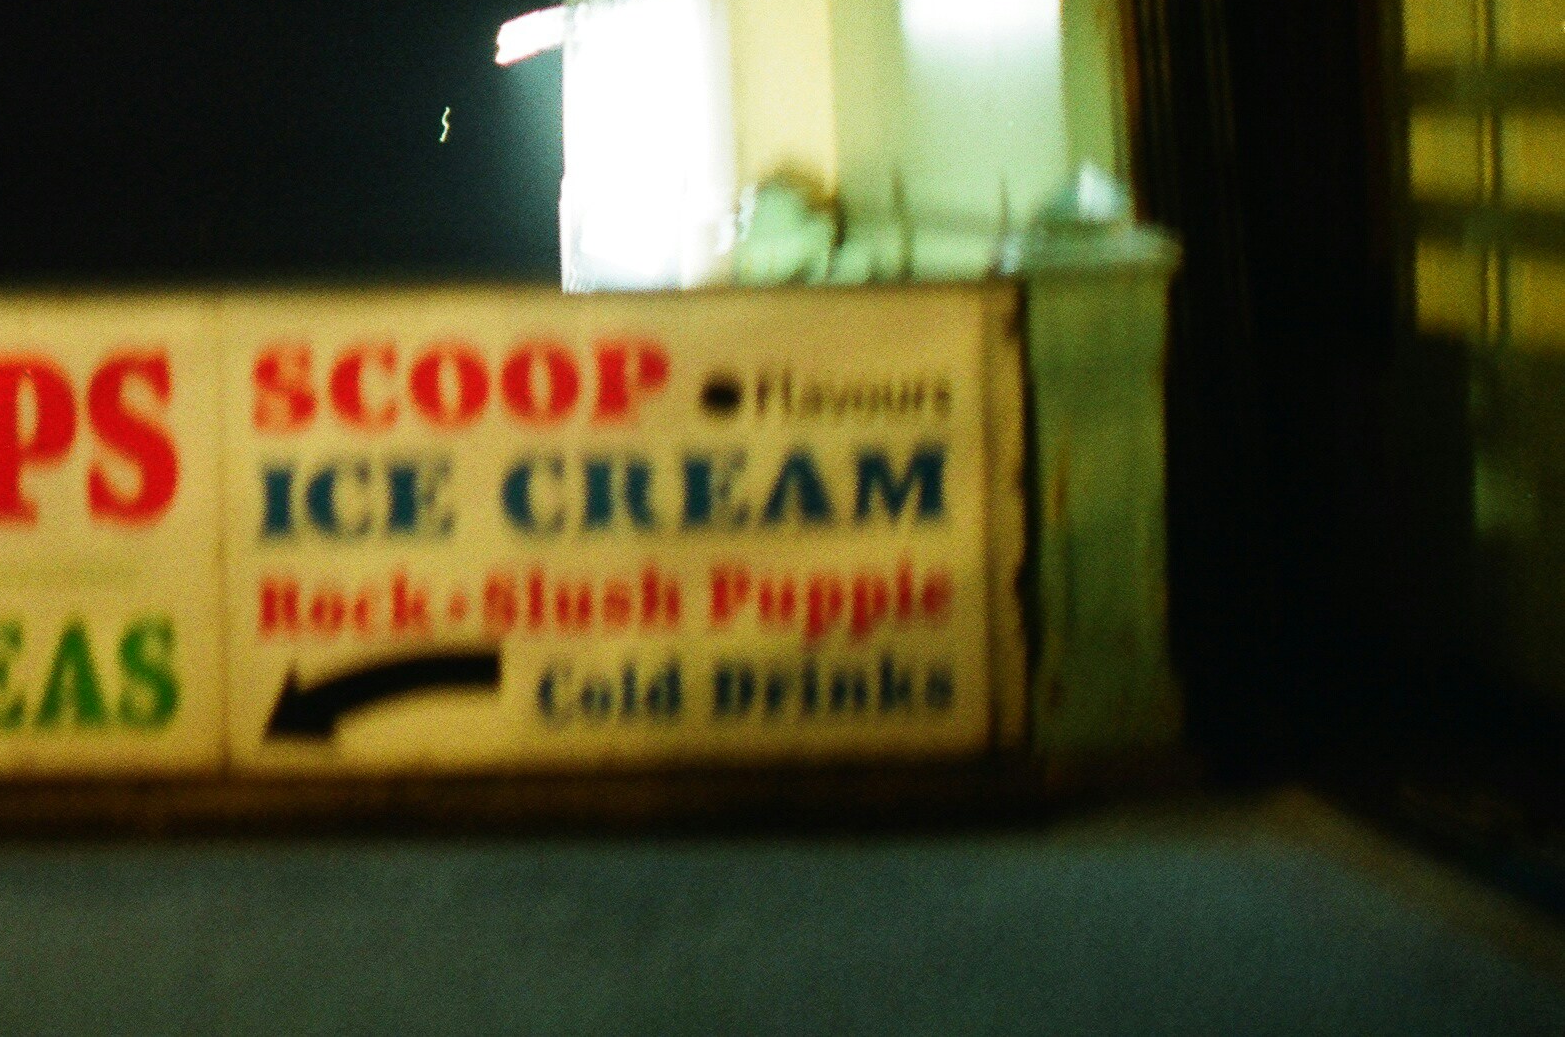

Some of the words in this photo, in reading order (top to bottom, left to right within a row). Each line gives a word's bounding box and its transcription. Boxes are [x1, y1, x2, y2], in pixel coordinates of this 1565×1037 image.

[253, 340, 673, 432] SCOOP
[261, 454, 455, 540] ICE
[501, 444, 947, 538] CREAM
[257, 574, 433, 636] Rock
[485, 564, 681, 634] Slush
[539, 664, 681, 722] Cold
[713, 659, 953, 719] Drinks
